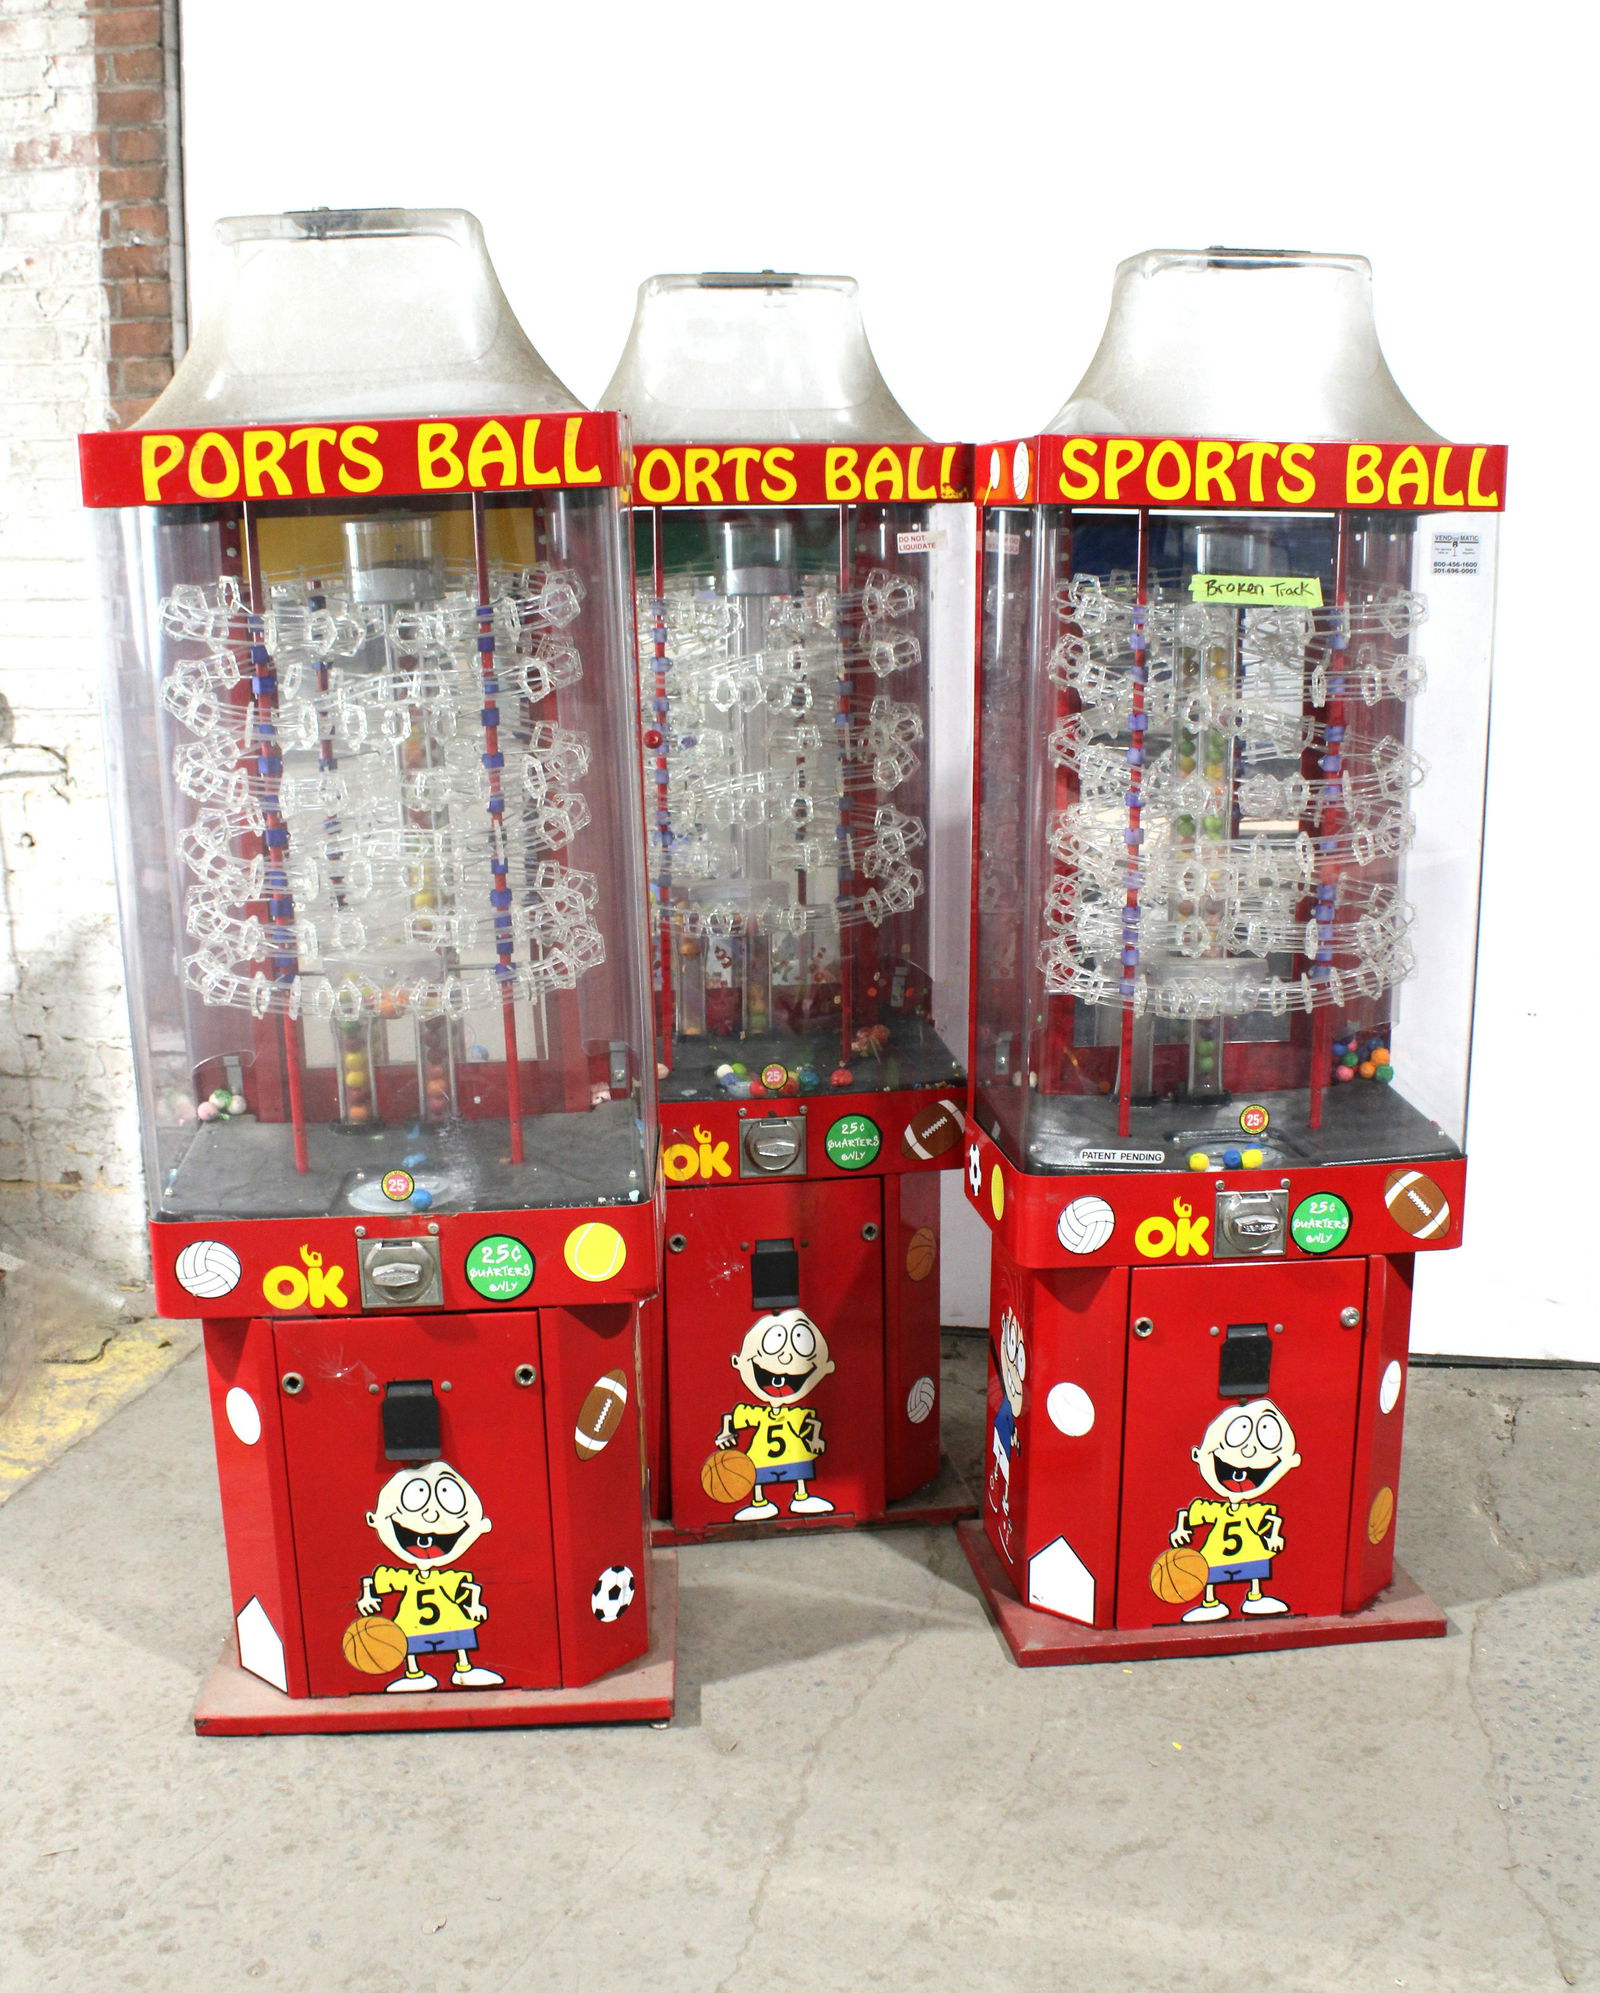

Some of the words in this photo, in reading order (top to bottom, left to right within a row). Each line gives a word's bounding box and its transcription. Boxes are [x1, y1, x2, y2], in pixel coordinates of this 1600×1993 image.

[141, 425, 384, 501] PORTS
[417, 417, 602, 489] BALL
[1059, 438, 1316, 504] SPORTS
[1346, 444, 1498, 507] BALL
[899, 542, 936, 551] LIQUIDATE
[1205, 579, 1264, 597] Broken
[1270, 581, 1315, 597] Track
[841, 1121, 866, 1135] 25¢
[827, 1135, 880, 1152] QUARTERS
[663, 1140, 732, 1182] OK
[840, 1150, 866, 1161] ONLY
[1081, 1151, 1117, 1160] PATENT
[1120, 1152, 1162, 1162] PENDING
[1308, 1200, 1336, 1215] 25¢
[1292, 1216, 1349, 1232] QUARTERS
[1134, 1214, 1211, 1258] OK
[1305, 1232, 1333, 1244] ONLY
[481, 1243, 522, 1264] 25¢
[468, 1263, 532, 1281] QUARTERS
[262, 1263, 348, 1310] OK
[488, 1280, 519, 1293] ONLY
[766, 1424, 787, 1458] 5
[1222, 1520, 1243, 1557] 5
[416, 1589, 441, 1626] 5
